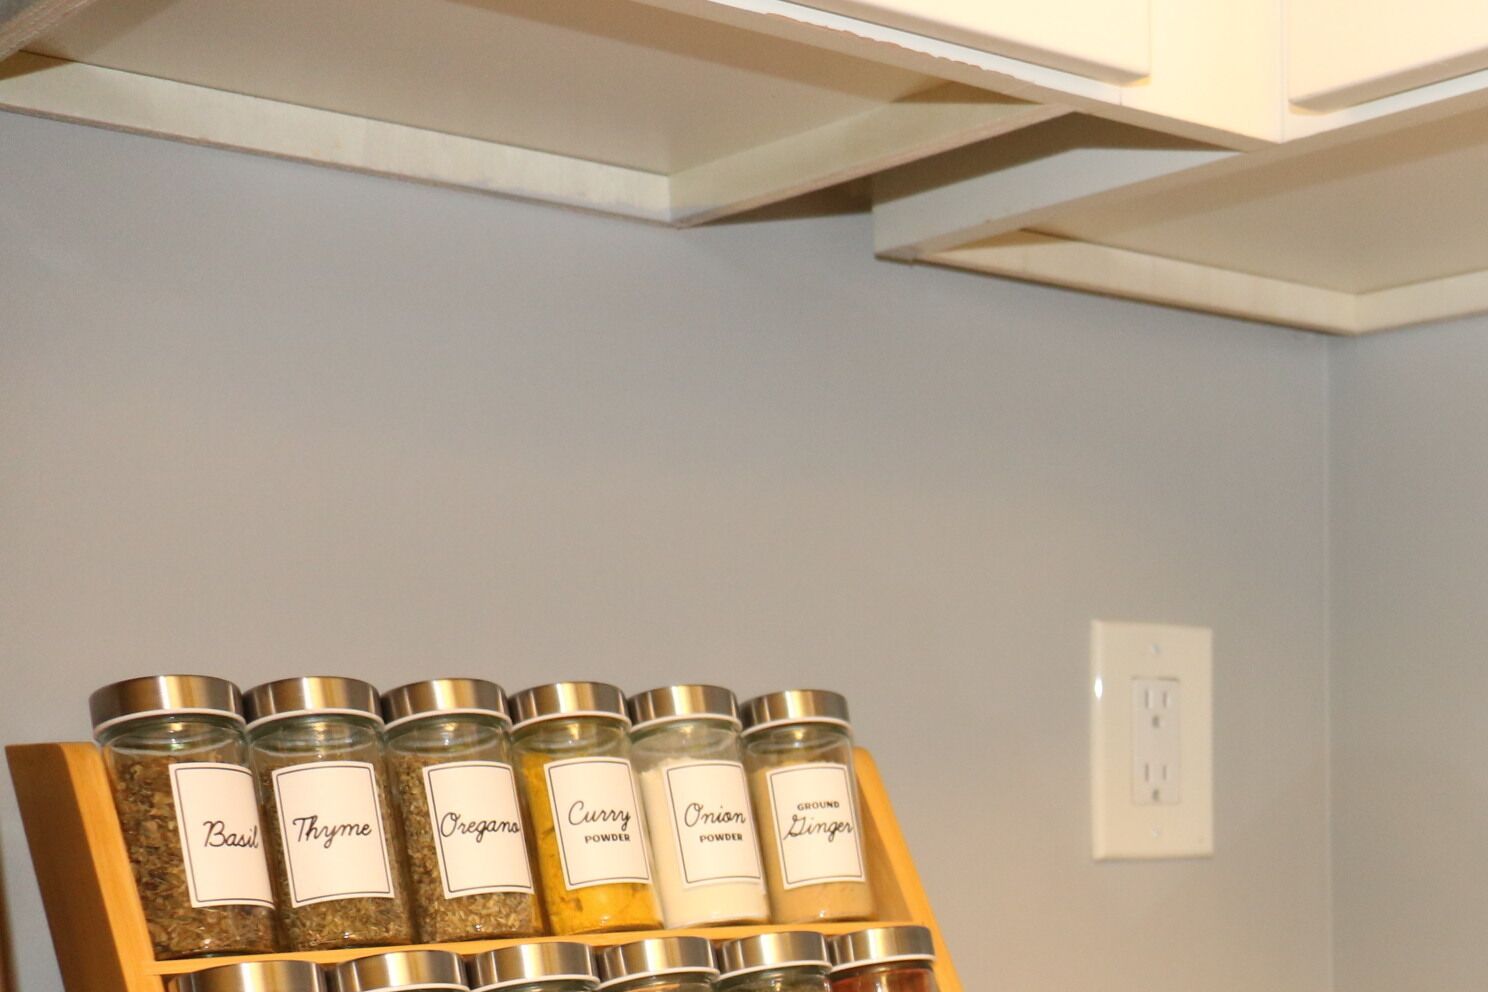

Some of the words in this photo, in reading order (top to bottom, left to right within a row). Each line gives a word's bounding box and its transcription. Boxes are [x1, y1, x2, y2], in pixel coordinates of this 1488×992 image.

[568, 800, 632, 833] Curry
[684, 802, 747, 829] Onion
[797, 801, 841, 812] GROUND
[203, 820, 259, 849] Basil
[293, 815, 373, 849] Thyme
[440, 812, 520, 843] Oregano
[584, 833, 632, 844] POWDER
[699, 833, 744, 844] POWDER
[783, 814, 855, 842] Ginger
